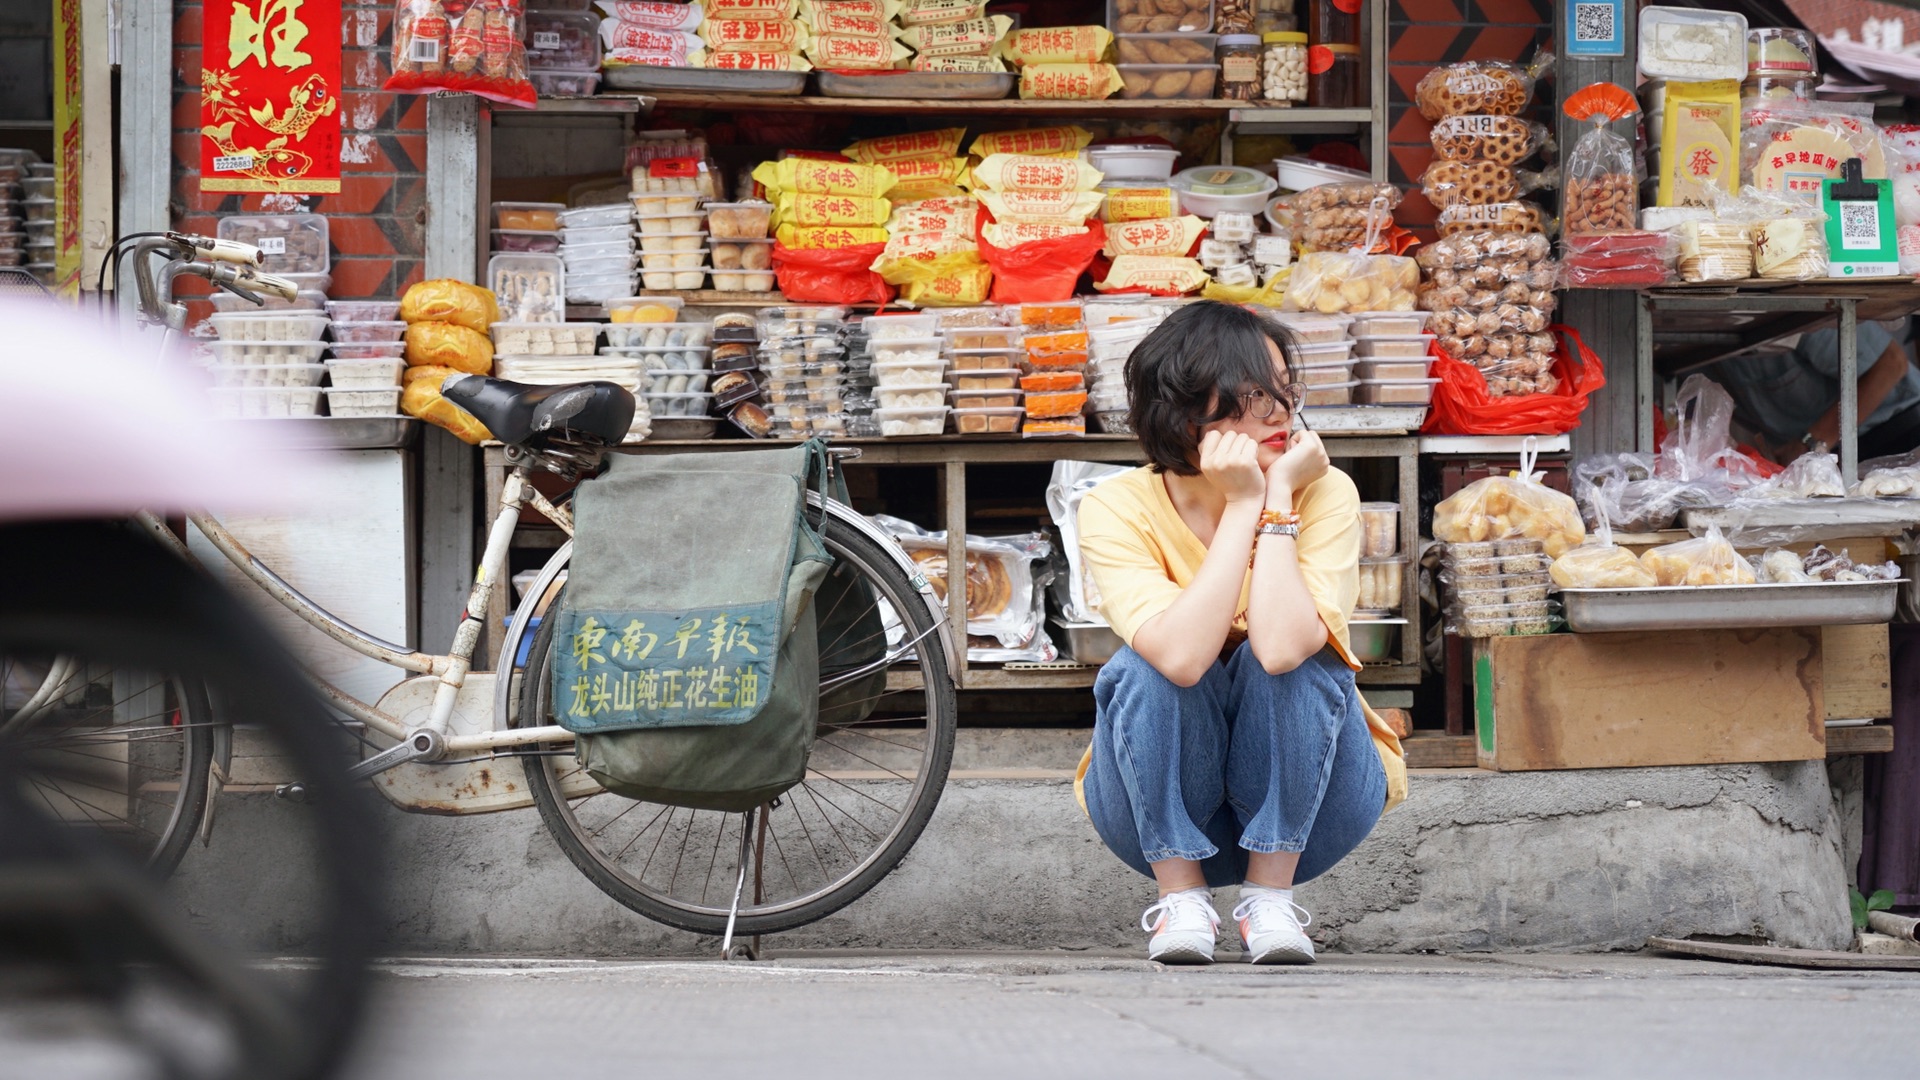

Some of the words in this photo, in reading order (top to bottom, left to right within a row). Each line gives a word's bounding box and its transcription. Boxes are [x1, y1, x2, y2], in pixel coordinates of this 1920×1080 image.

[228, 0, 312, 73] 旺
[216, 161, 251, 169] 22226883
[1688, 149, 1718, 175] 發
[1771, 151, 1838, 171] 古早地瓜饼
[567, 665, 758, 718] 龙头山纯正花生油
